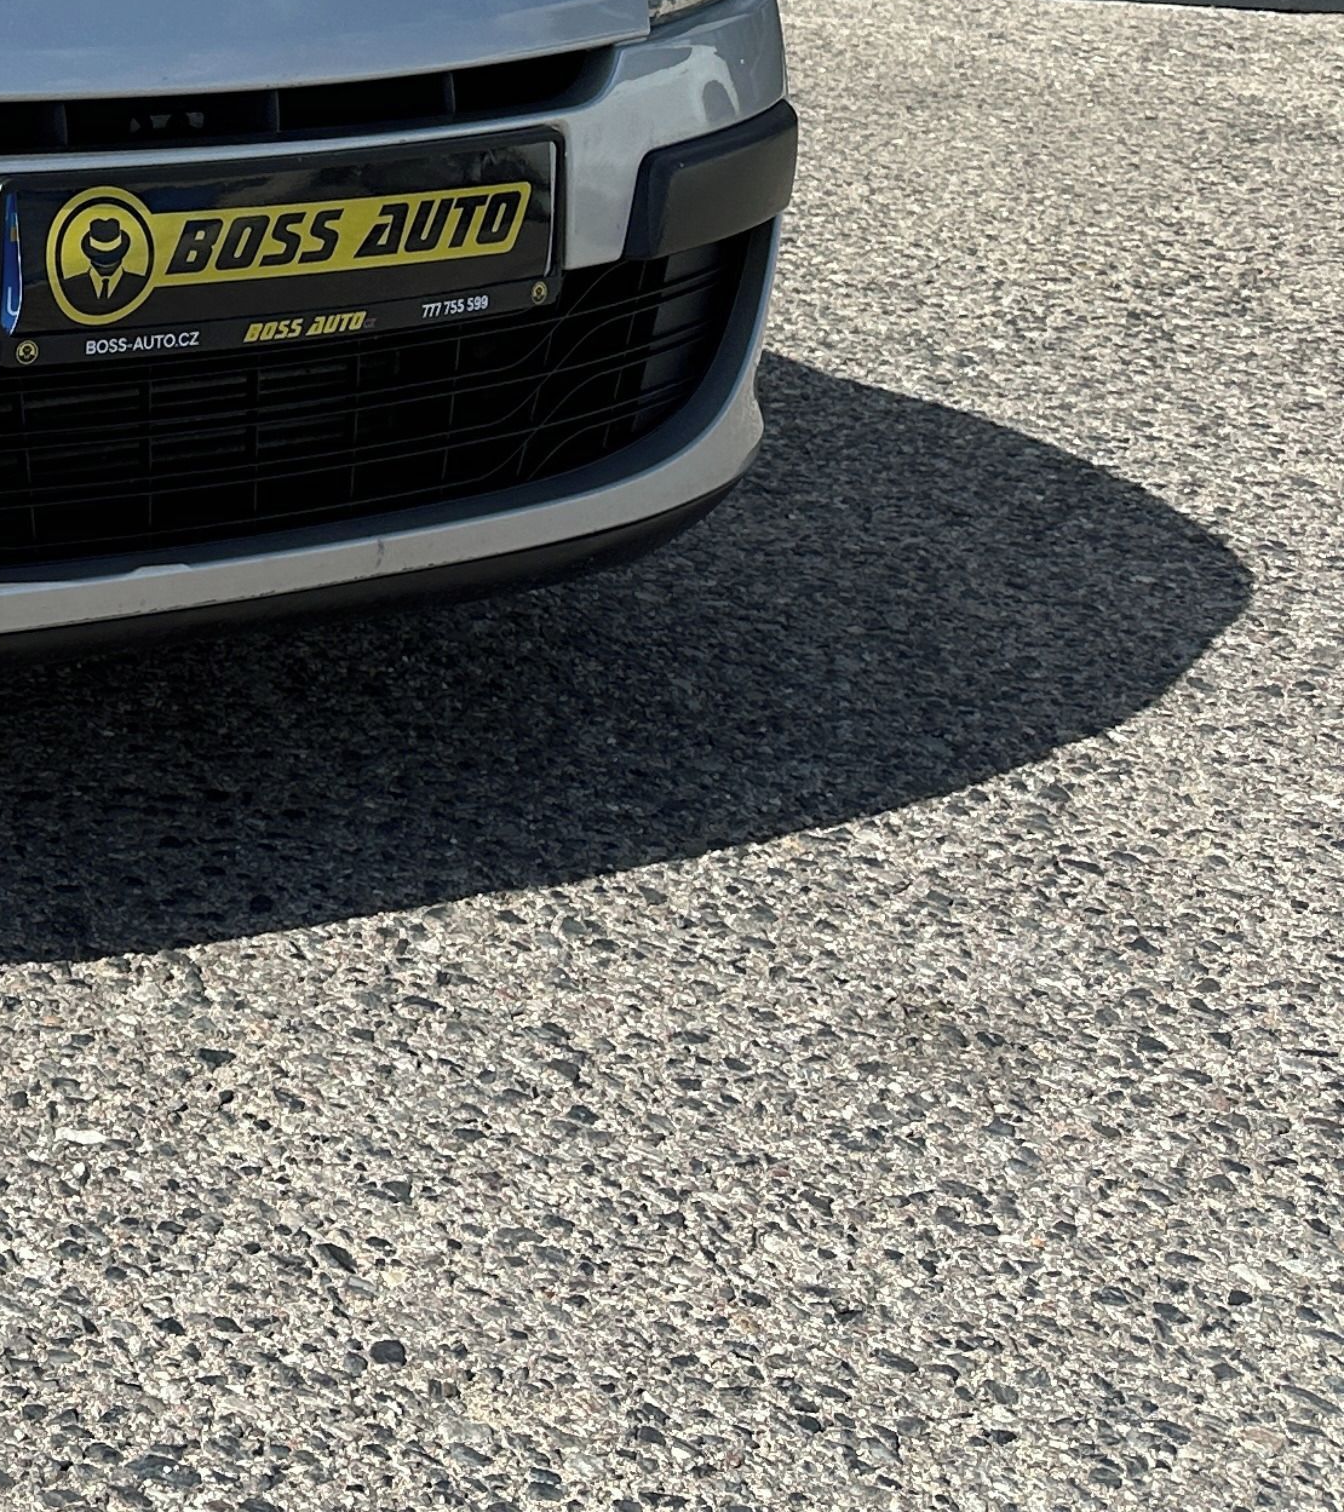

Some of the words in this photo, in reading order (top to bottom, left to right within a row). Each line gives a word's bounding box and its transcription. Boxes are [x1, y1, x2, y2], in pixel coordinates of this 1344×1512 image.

[165, 208, 345, 275] BOSS
[353, 190, 523, 259] AUTO
[421, 302, 442, 319] 777
[443, 299, 465, 315] 755
[466, 295, 489, 313] 599
[242, 318, 303, 343] BOSS
[306, 311, 367, 337] AUTO
[85, 331, 200, 355] BOSS-AUTO.CZ
